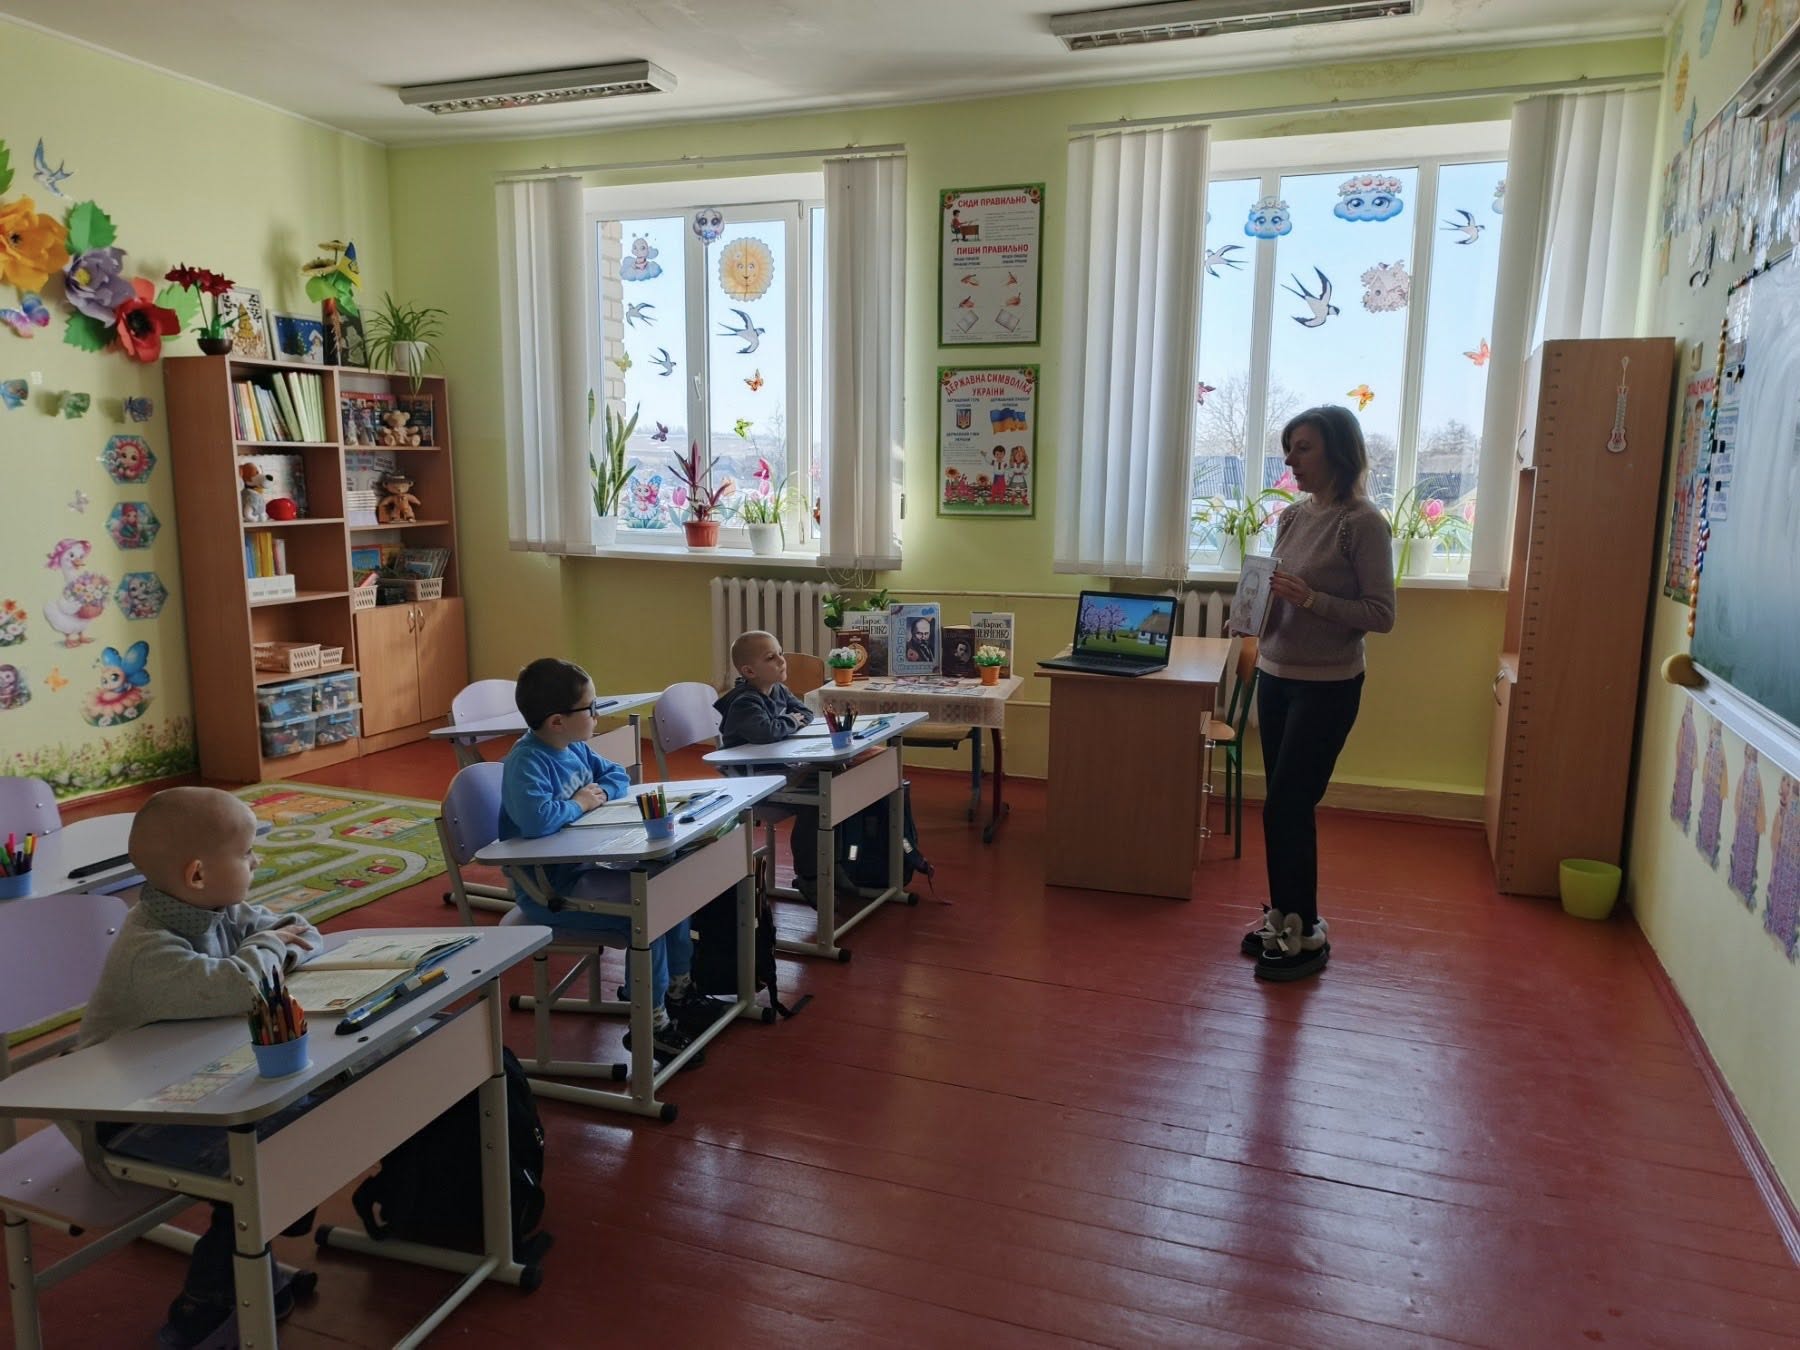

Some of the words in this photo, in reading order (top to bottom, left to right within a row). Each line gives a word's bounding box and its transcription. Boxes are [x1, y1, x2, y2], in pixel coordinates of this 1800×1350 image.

[958, 199, 979, 208] СИДИ
[980, 196, 1027, 207] ПРАВИЛЬНО
[956, 247, 981, 255] ПИШИ
[982, 244, 1029, 254] ПРАВИЛЬНО
[945, 375, 986, 396] ДЕРЖАВНА
[987, 373, 1033, 396] СИМВОЛІКА
